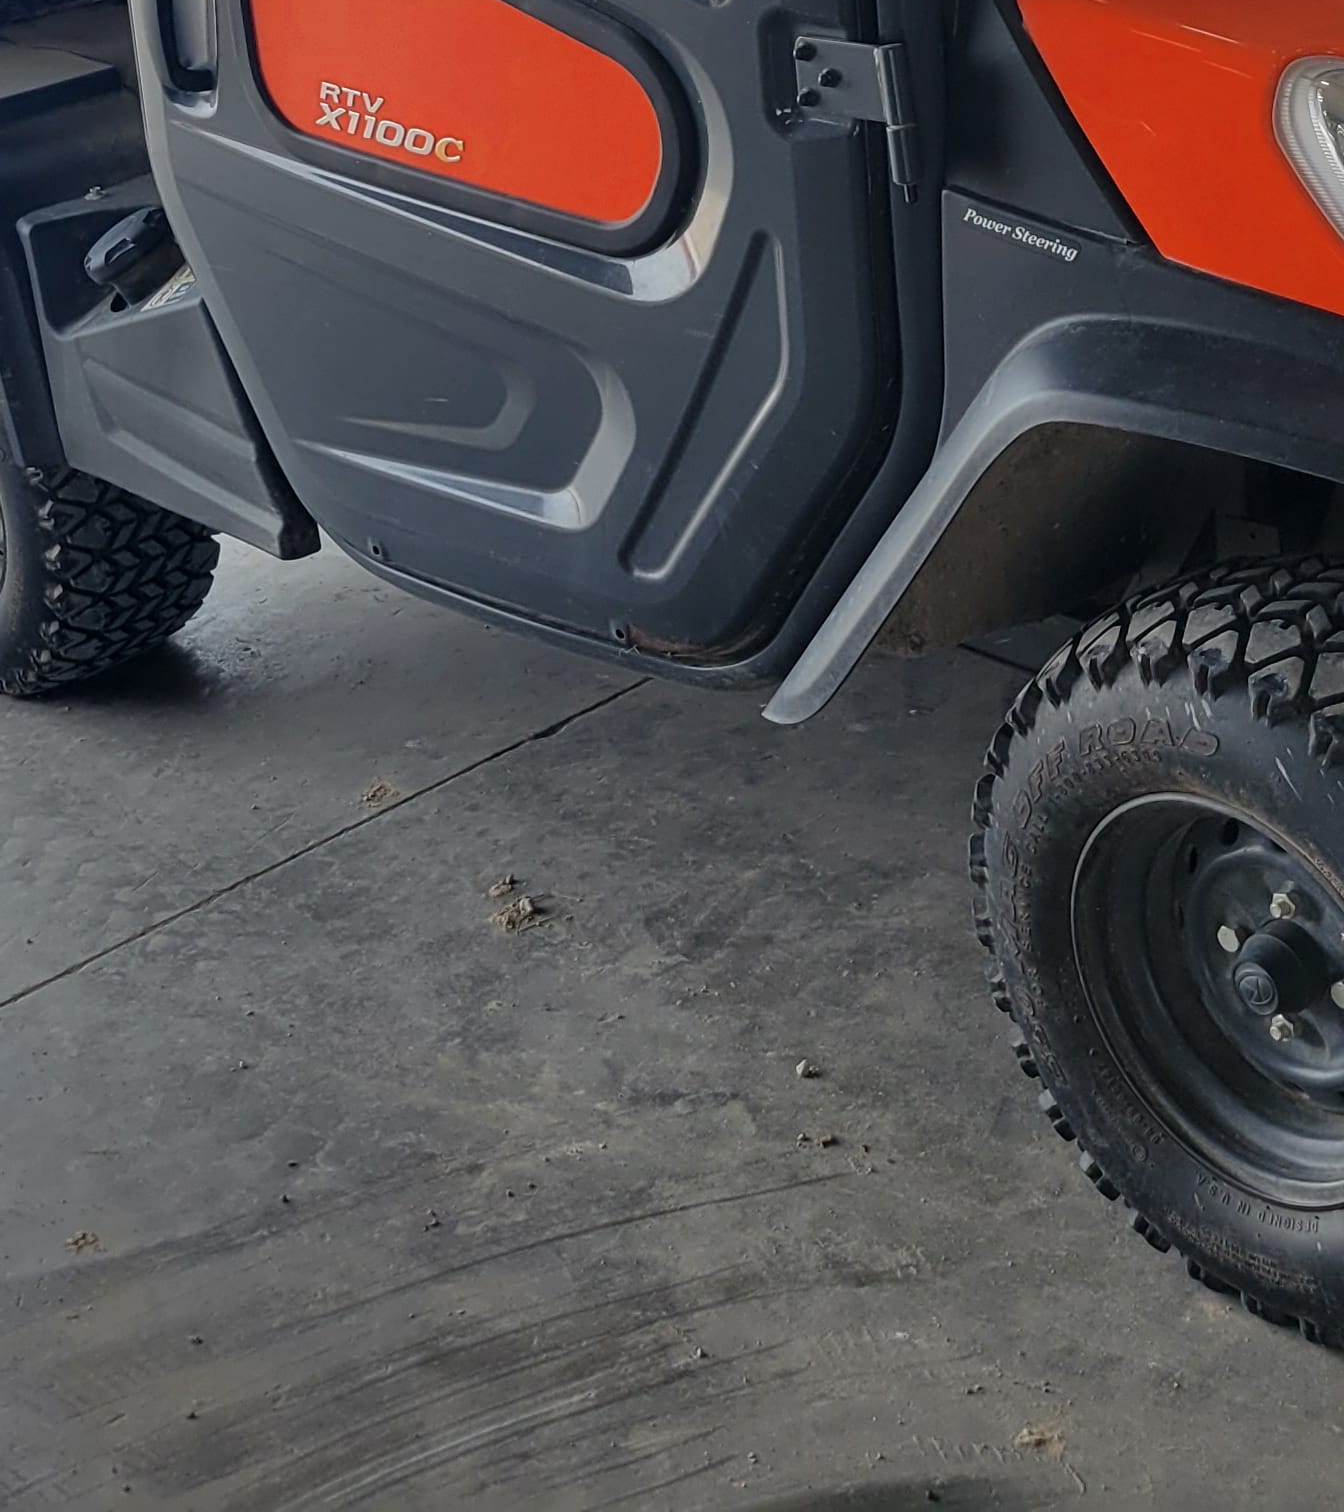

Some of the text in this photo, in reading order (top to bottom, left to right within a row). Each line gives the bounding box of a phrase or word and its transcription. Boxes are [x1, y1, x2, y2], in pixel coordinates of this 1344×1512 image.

[319, 81, 384, 114] RTV
[315, 102, 464, 163] X1100C
[963, 208, 1078, 262] Power Steering
[1013, 737, 1066, 830] OFF
[1079, 717, 1220, 758] ROAD
